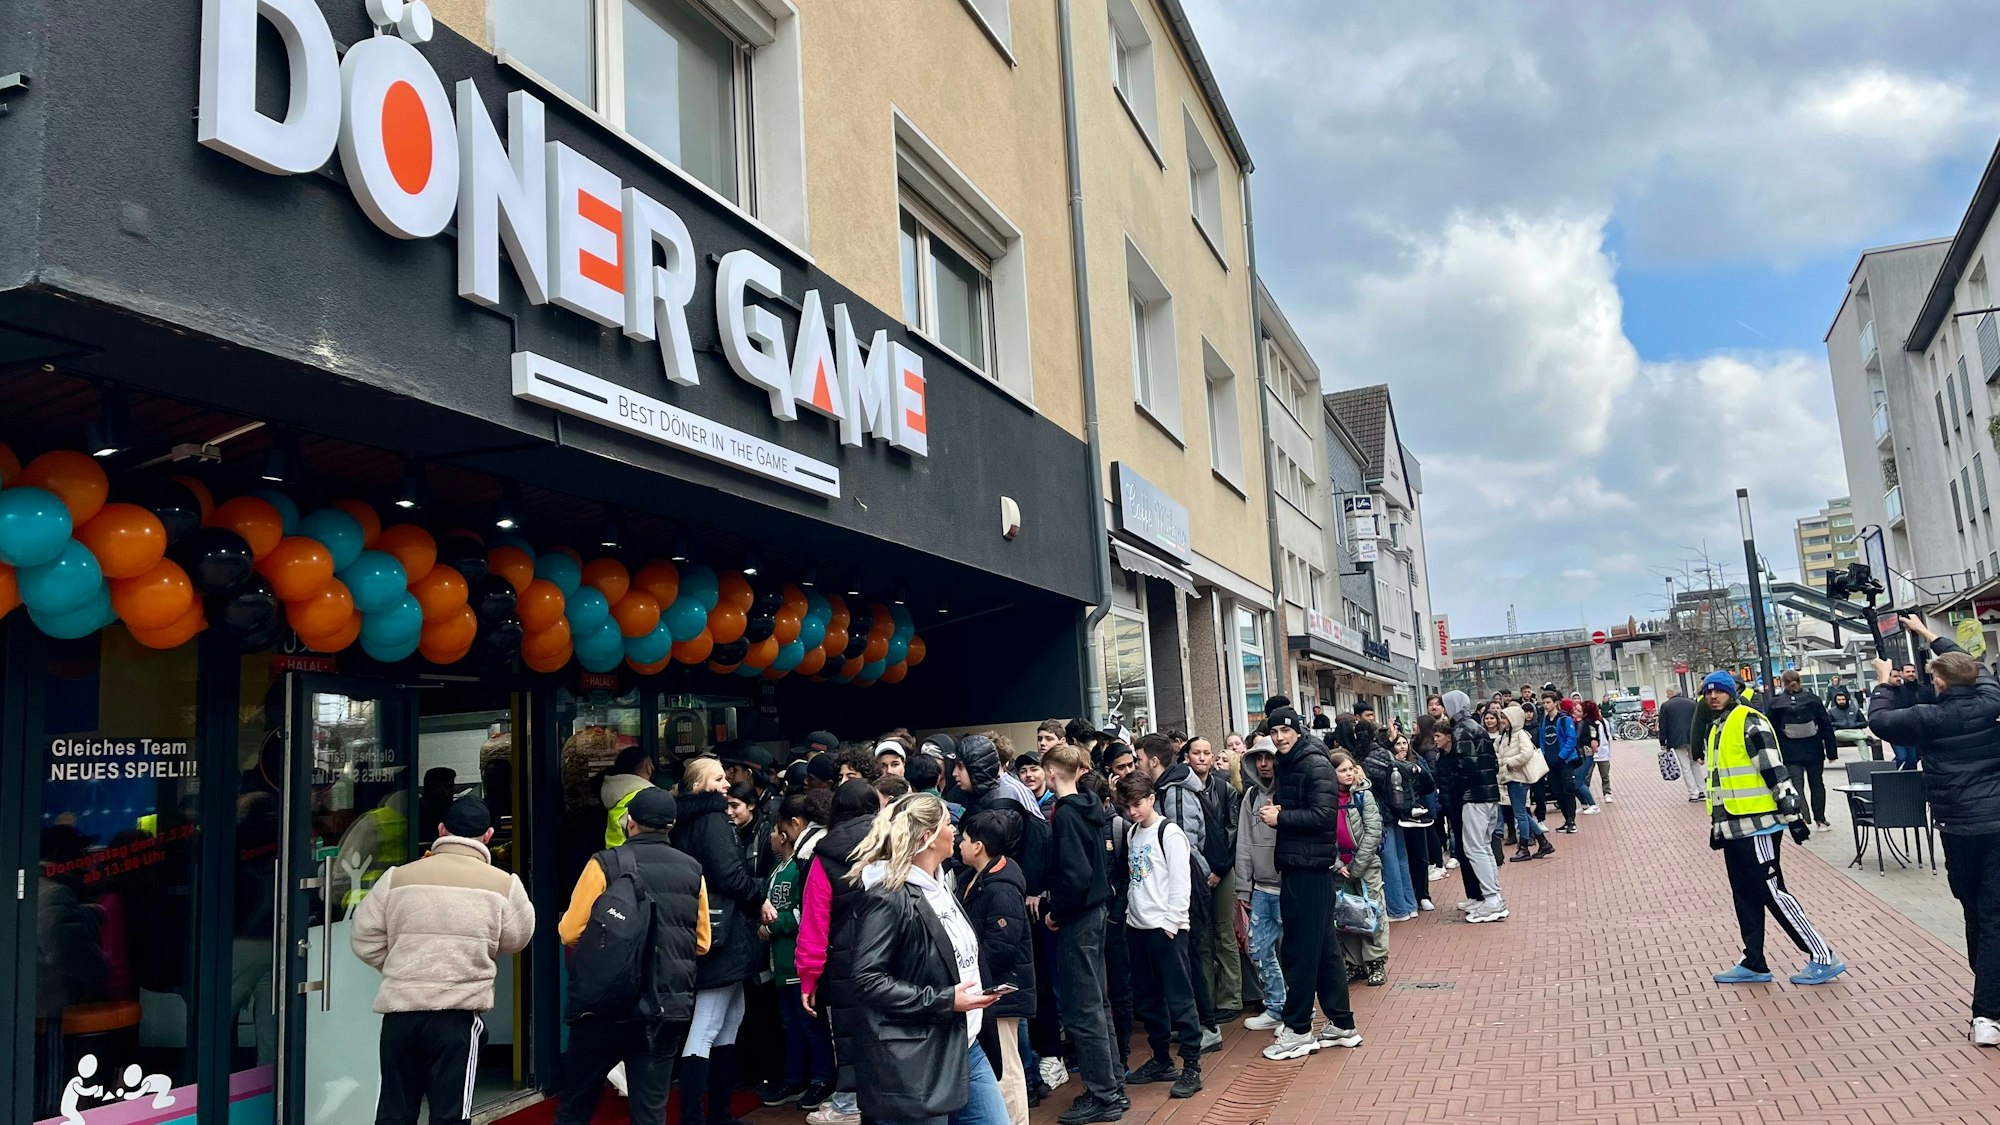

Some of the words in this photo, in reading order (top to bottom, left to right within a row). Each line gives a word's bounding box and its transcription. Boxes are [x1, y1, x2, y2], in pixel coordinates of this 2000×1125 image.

[198, 0, 700, 387] DÖNER
[715, 248, 929, 458] GAME
[1433, 620, 1449, 656] wupsi
[286, 658, 323, 673] HALAL
[589, 676, 612, 687] HALAL
[51, 738, 136, 757] Gleiches
[140, 738, 188, 756] Team
[51, 761, 120, 781] NEUES
[124, 760, 199, 779] SPIEL!!!
[45, 845, 129, 878] Donnerstag
[82, 868, 101, 886] ab
[143, 849, 167, 866] Uhr
[772, 881, 792, 908] SF
